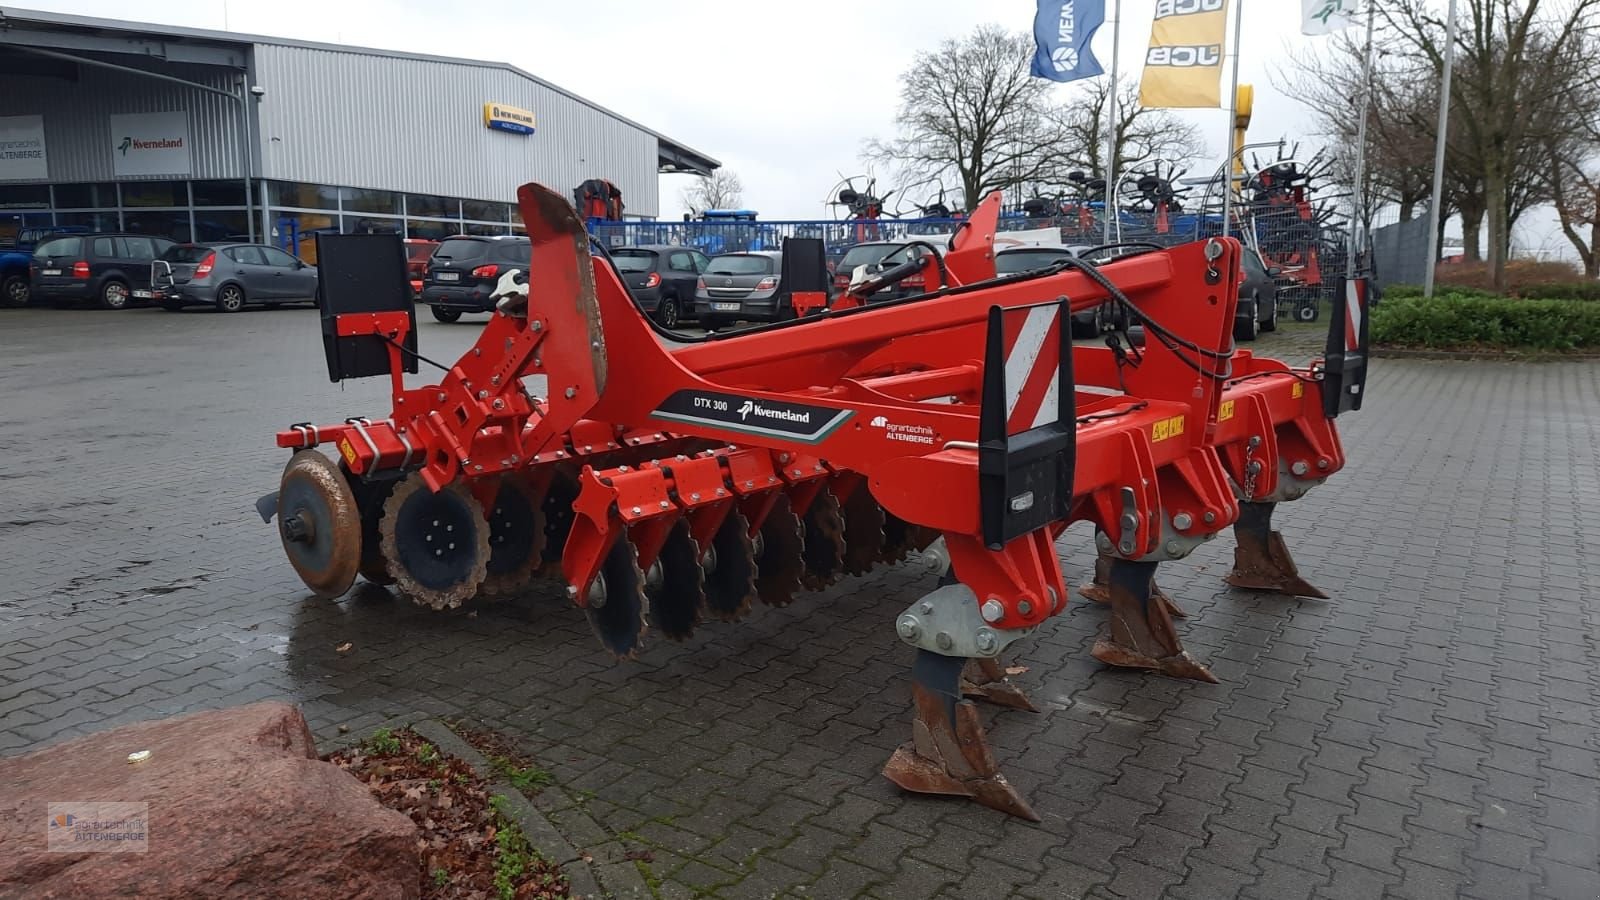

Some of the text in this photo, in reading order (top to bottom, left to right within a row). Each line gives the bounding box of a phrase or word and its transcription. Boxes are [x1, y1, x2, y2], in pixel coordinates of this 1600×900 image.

[132, 137, 183, 150] Kverneland
[693, 397, 728, 412] DTX 300
[754, 404, 810, 424] Kverneland
[886, 422, 933, 436] agrartechnik
[886, 432, 934, 445] ALTENBERGE
